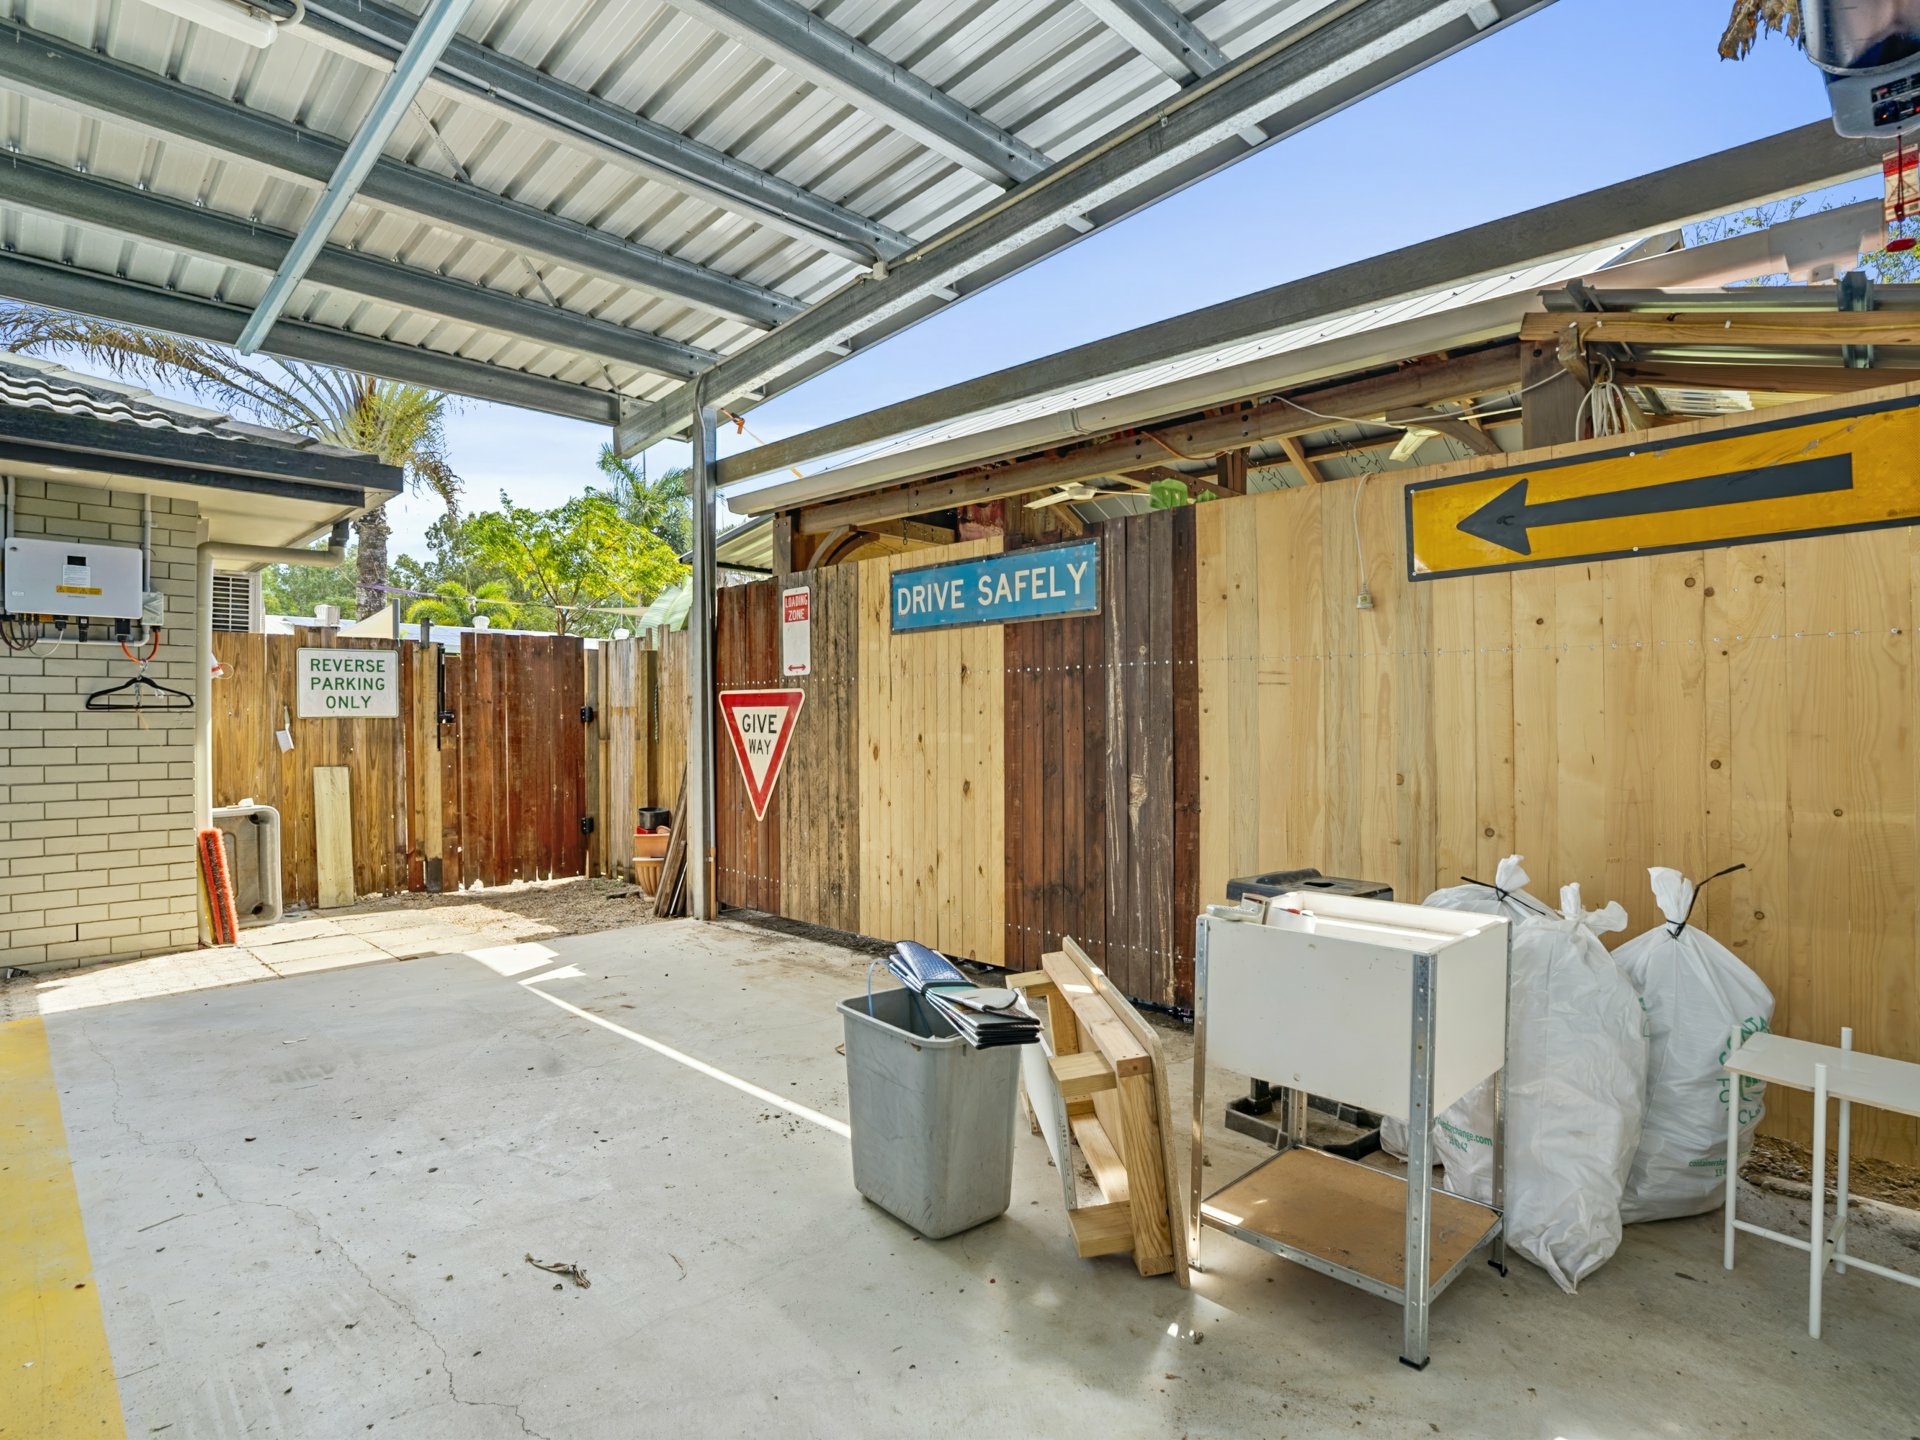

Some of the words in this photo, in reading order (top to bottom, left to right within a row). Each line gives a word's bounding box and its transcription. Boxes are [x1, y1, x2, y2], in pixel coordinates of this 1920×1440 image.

[897, 579, 965, 616] DRIVE
[977, 561, 1088, 606] SAFELY
[785, 594, 808, 608] LOADING
[788, 608, 805, 621] ZONE
[310, 658, 386, 673] REVERSE
[310, 677, 385, 691] PARKING
[326, 695, 372, 709] ONLY
[742, 714, 777, 734] GIVE
[748, 738, 772, 755] WAY
